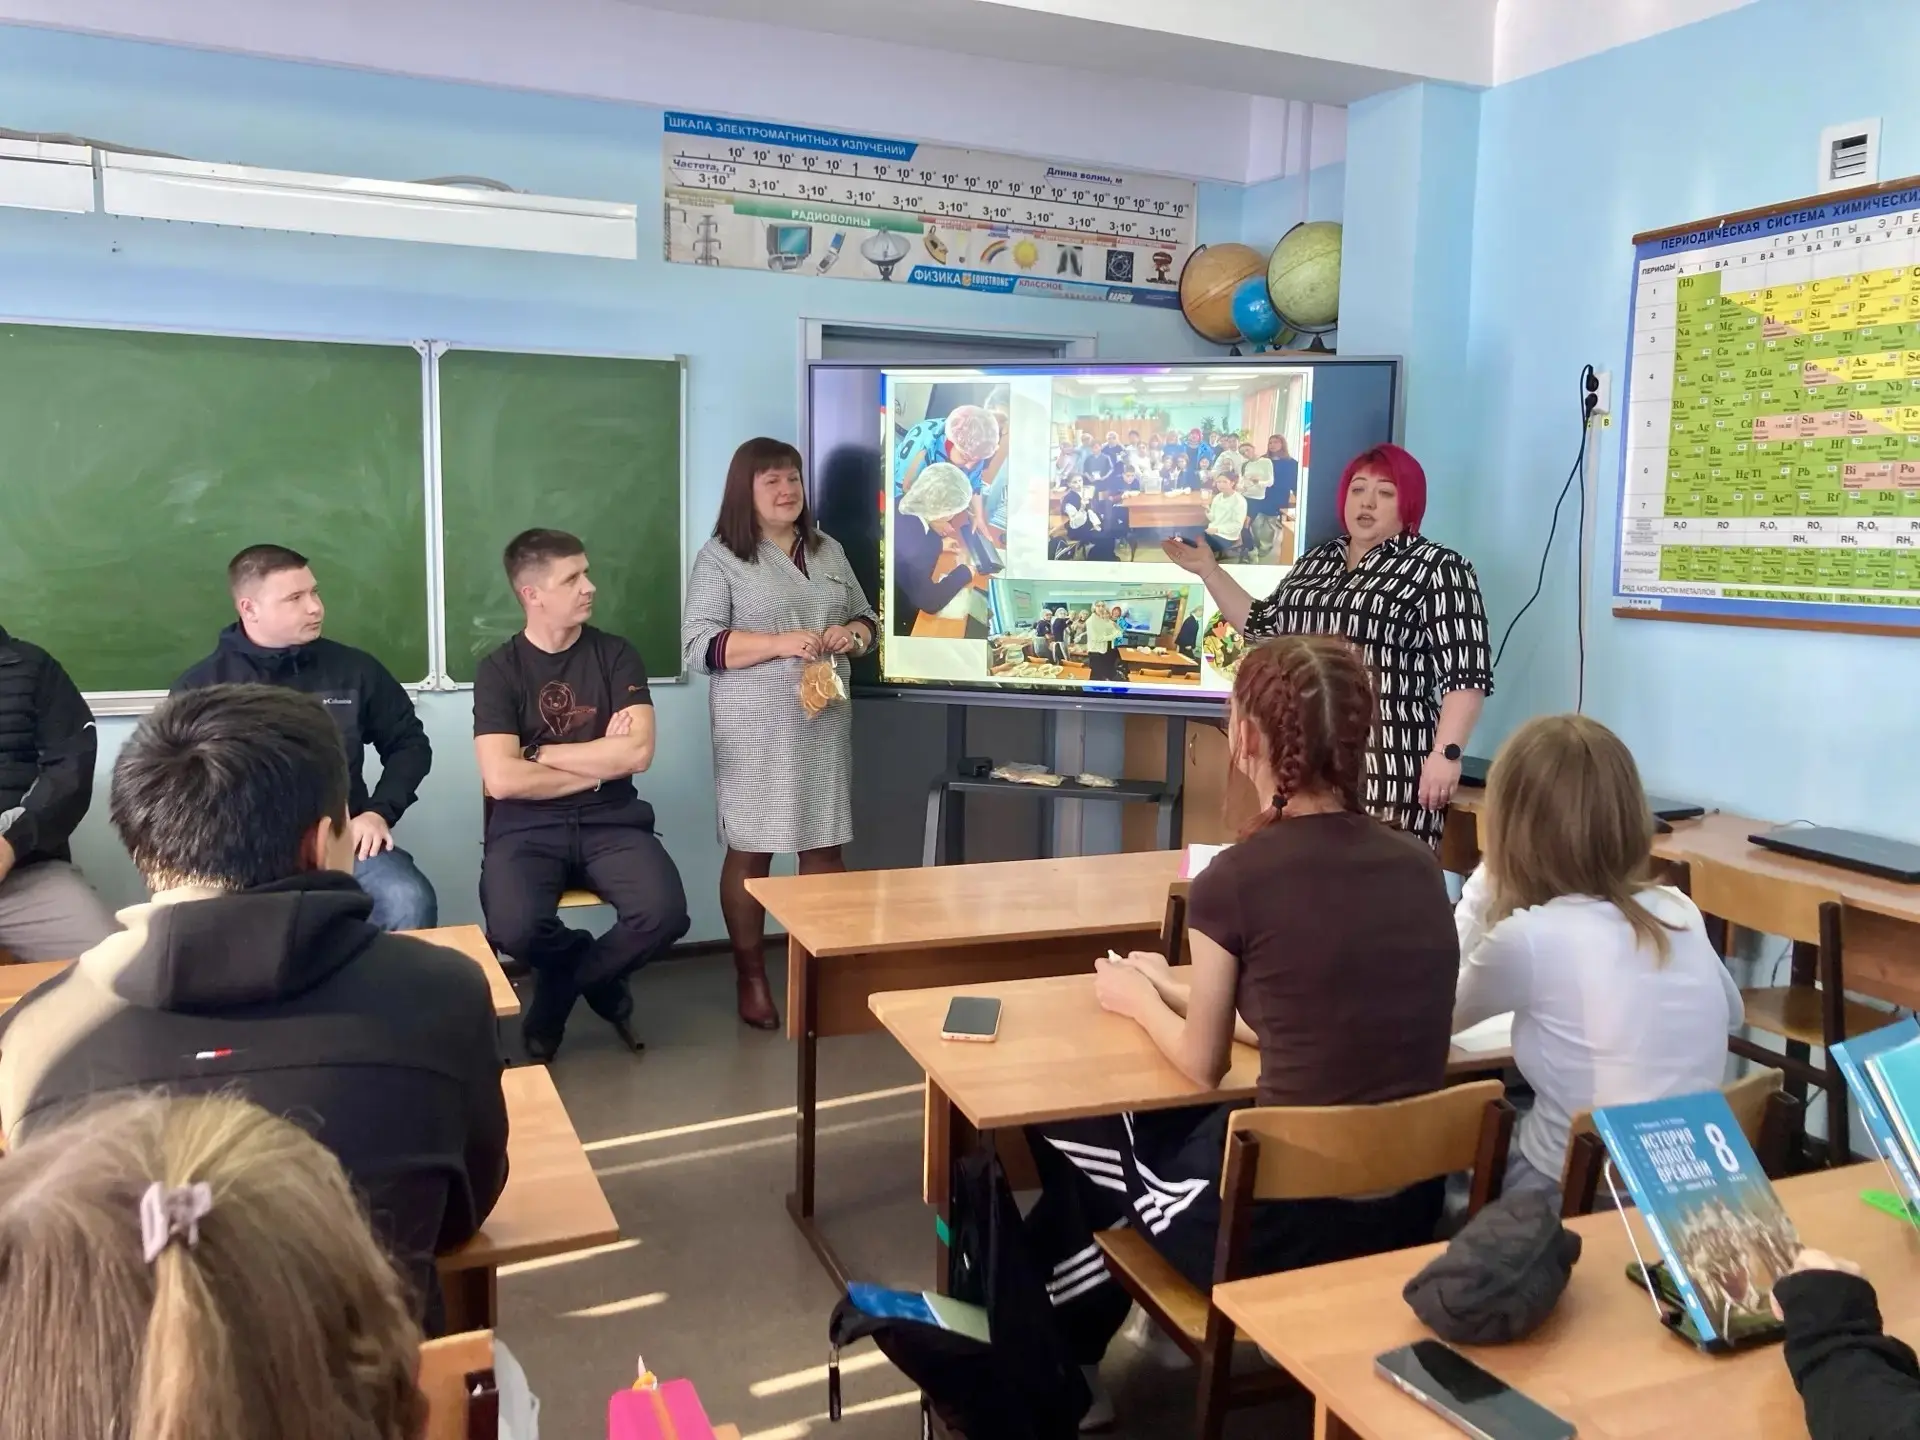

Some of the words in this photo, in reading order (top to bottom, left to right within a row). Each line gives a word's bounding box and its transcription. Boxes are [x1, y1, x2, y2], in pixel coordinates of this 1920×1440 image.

[669, 117, 712, 132] ШКАЛА
[716, 123, 839, 147] ЭЛЕКТРОМАГНИТНЫХ
[841, 138, 906, 156] ИЗЛУЧЕНИЙ
[673, 158, 720, 172] Частота,
[722, 164, 736, 175] Гц
[1046, 167, 1078, 178] Длина
[1080, 172, 1113, 184] волны,
[791, 209, 871, 227] РАДИОВОЛНЫ
[1661, 221, 1760, 250] ПЕРИОДИЧЕСКАЯ
[1766, 208, 1826, 230] СИСТЕМА
[1832, 190, 1920, 217] ХИМИЧЕСКИ
[1641, 262, 1676, 275] ПЕРИОДЫ
[913, 269, 961, 285] ФИЗИКА
[1862, 275, 1871, 284] N
[1019, 279, 1064, 291] КЛАССНОЕ
[1678, 277, 1694, 289] (H)
[1812, 283, 1819, 292] C
[1765, 290, 1773, 299] B
[1720, 296, 1732, 306] Be
[1911, 296, 1919, 305] S
[1678, 303, 1688, 312] Li
[1858, 303, 1866, 312] P
[1810, 309, 1820, 319] Si
[1764, 315, 1775, 324] Al
[1678, 328, 1690, 336] Na
[1719, 322, 1733, 332] Mg
[1843, 331, 1853, 341] Ti
[1793, 338, 1805, 348] Sc
[1717, 347, 1729, 356] Ca
[1805, 362, 1818, 372] Ge
[1853, 357, 1868, 367] As
[1745, 369, 1757, 378] Zn
[1760, 367, 1772, 377] Ga
[1701, 373, 1713, 383] Cu
[1837, 386, 1848, 395] Zr
[1886, 381, 1903, 391] Nb
[1673, 400, 1685, 409] Rb
[1713, 396, 1725, 406] Sr
[1848, 411, 1863, 421] Sb
[1904, 408, 1918, 418] Te
[1741, 419, 1753, 429] Cd
[1755, 419, 1766, 428] In
[1801, 415, 1814, 424] Sn
[1697, 423, 1710, 432] Ag
[1831, 439, 1845, 449] Hf
[1884, 437, 1898, 447] Ta
[1669, 448, 1679, 457] Cs
[1710, 446, 1721, 455] Ba
[1752, 469, 1761, 478] Tl
[1797, 467, 1810, 476] Pb
[1845, 465, 1856, 475] Bi
[1900, 464, 1915, 473] Po
[1693, 472, 1706, 480] Au
[1735, 470, 1750, 479] Hg
[1666, 496, 1676, 504] Fr
[1706, 495, 1719, 504] Ra
[1827, 492, 1840, 502] Rf
[1879, 492, 1894, 501] Db
[1717, 521, 1730, 529] RO
[1911, 521, 1920, 530] R
[1640, 1127, 1696, 1150] ИСТОРИЯ
[1704, 1122, 1740, 1173] 8
[1651, 1145, 1697, 1166] НОВОГО
[1656, 1159, 1714, 1183] ВРЕМЕНИ
